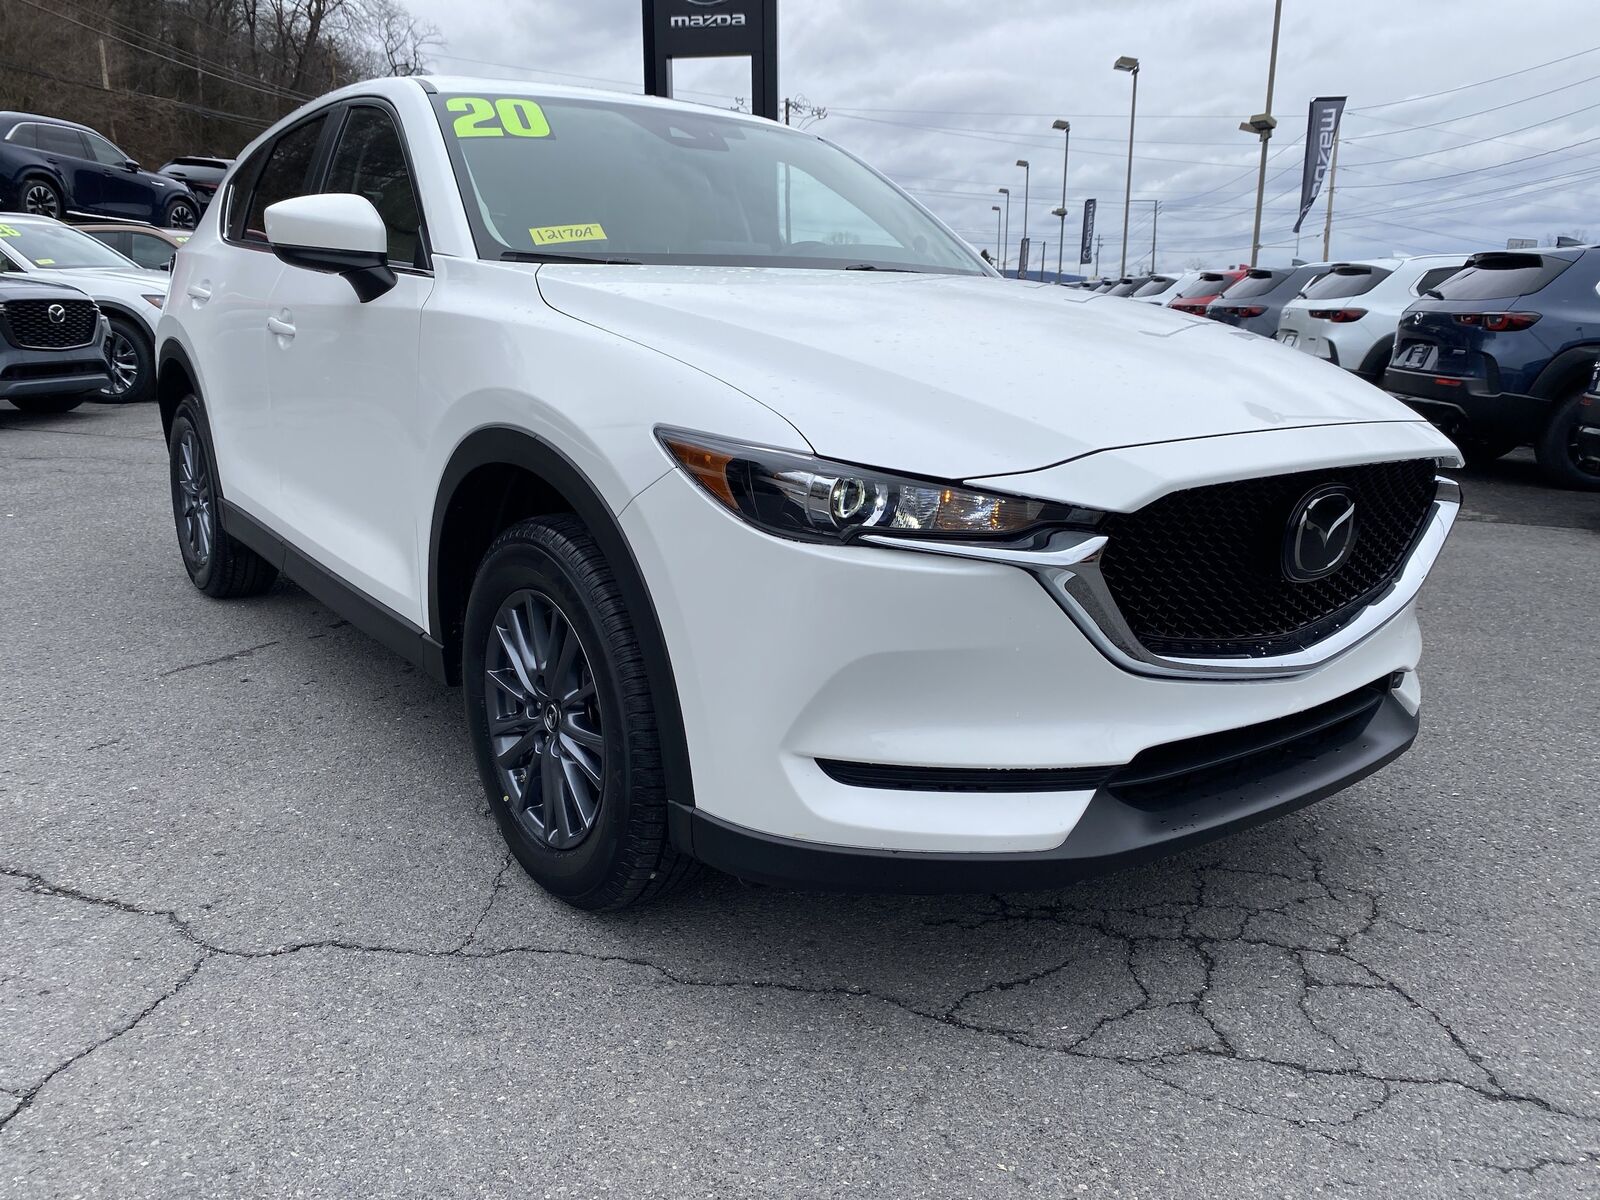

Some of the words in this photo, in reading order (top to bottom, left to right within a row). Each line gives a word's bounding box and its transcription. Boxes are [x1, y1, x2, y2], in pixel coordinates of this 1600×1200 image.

[670, 13, 746, 28] mazda
[446, 97, 550, 138] 20
[536, 226, 594, 242] 12170A
